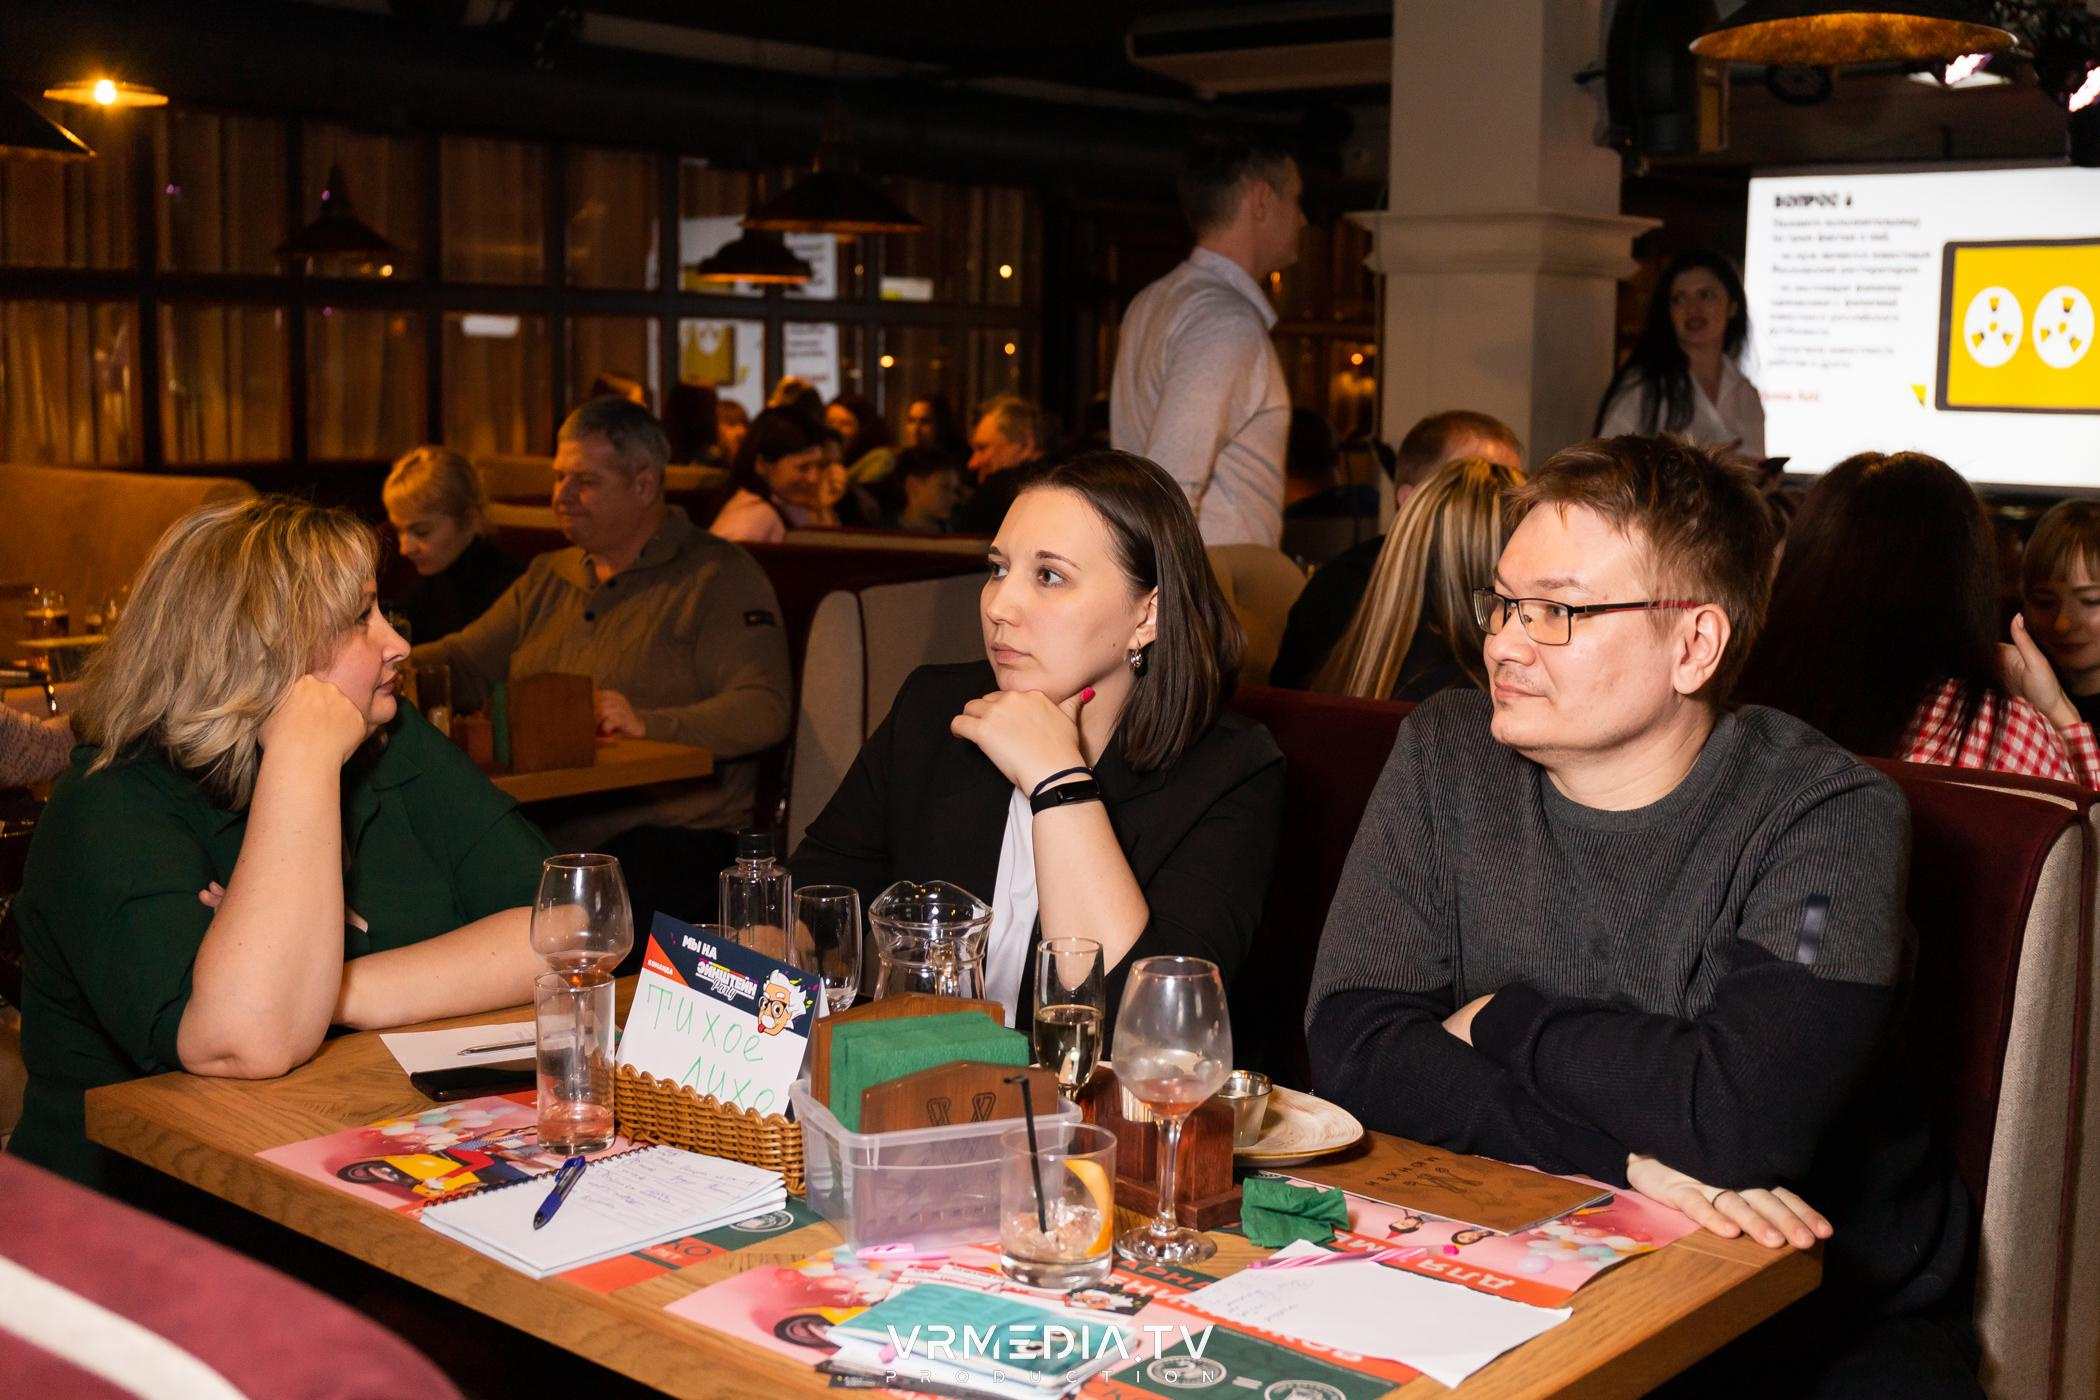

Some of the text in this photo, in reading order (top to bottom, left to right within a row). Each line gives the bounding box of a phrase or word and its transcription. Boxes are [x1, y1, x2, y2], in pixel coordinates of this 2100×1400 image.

[682, 935, 717, 960] МЫ НА
[647, 959, 674, 975] КОМАНДА
[711, 978, 737, 1001] Party
[1417, 1258, 1516, 1290] ДЛЯ
